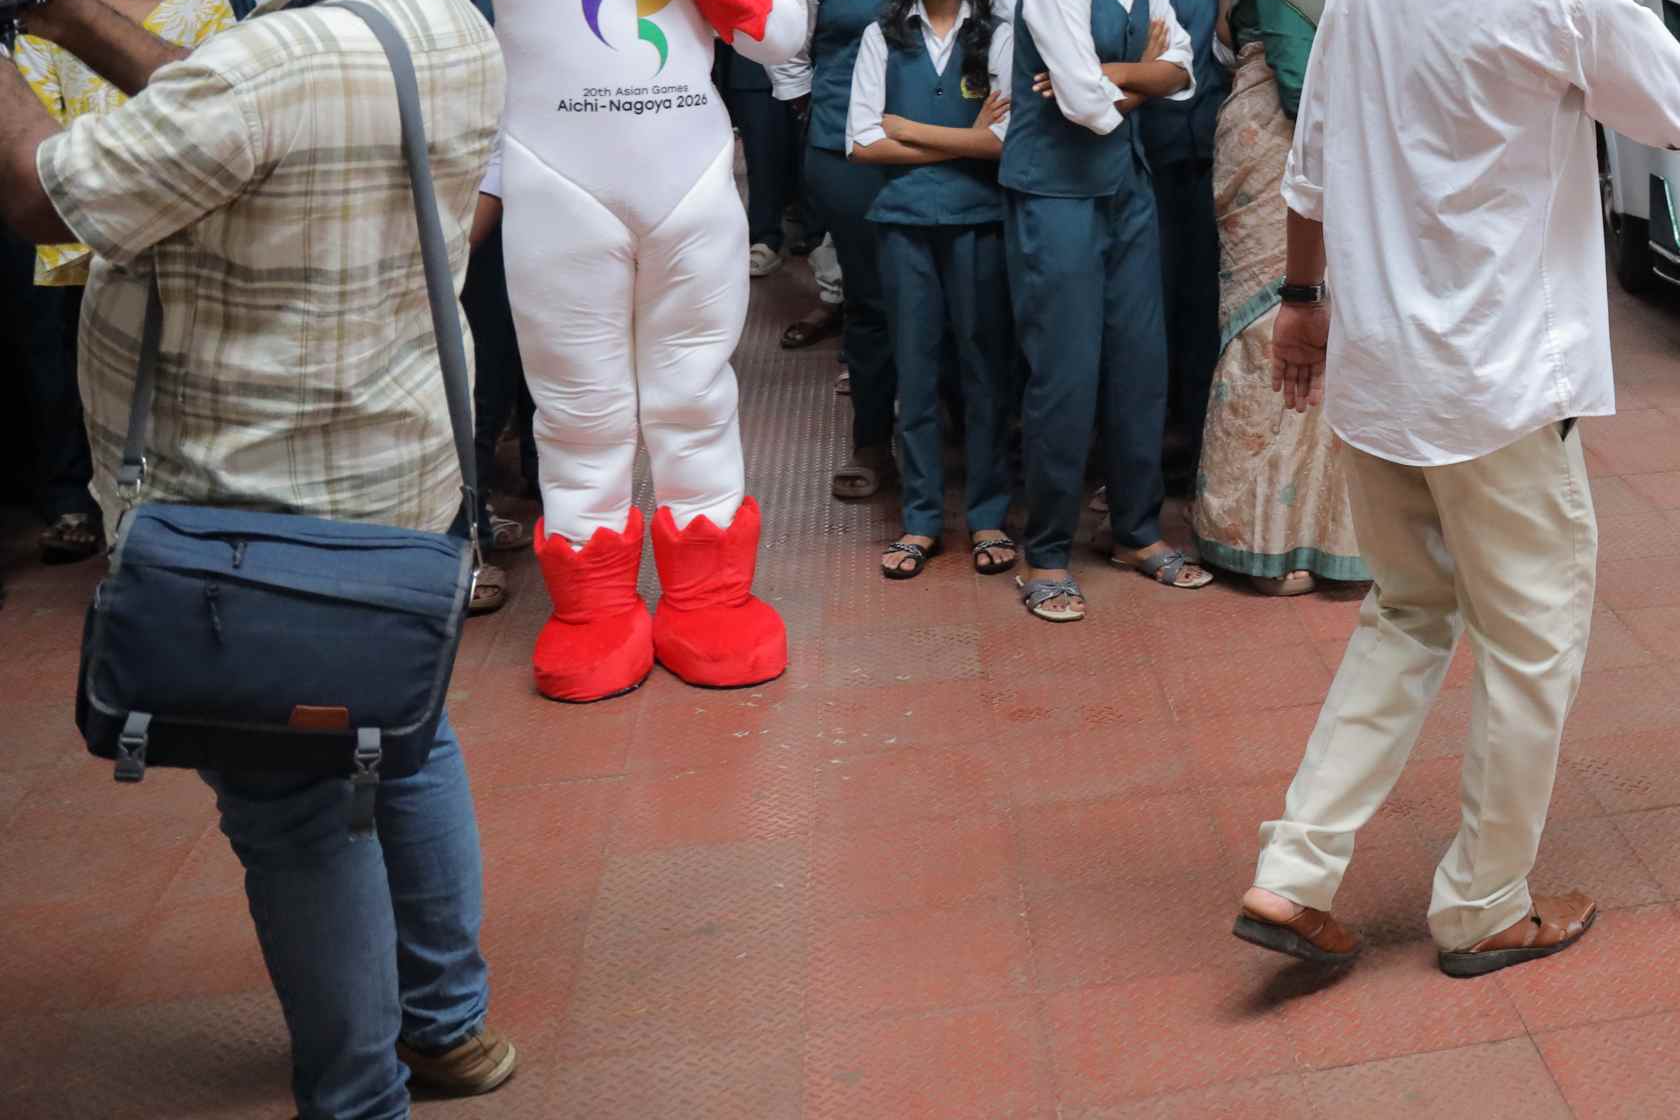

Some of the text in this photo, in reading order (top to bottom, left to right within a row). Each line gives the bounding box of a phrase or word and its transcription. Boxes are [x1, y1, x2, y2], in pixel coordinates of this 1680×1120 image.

[583, 84, 688, 97] 20th Asian Games
[557, 93, 708, 115] Aichi-Nagoya 2026
